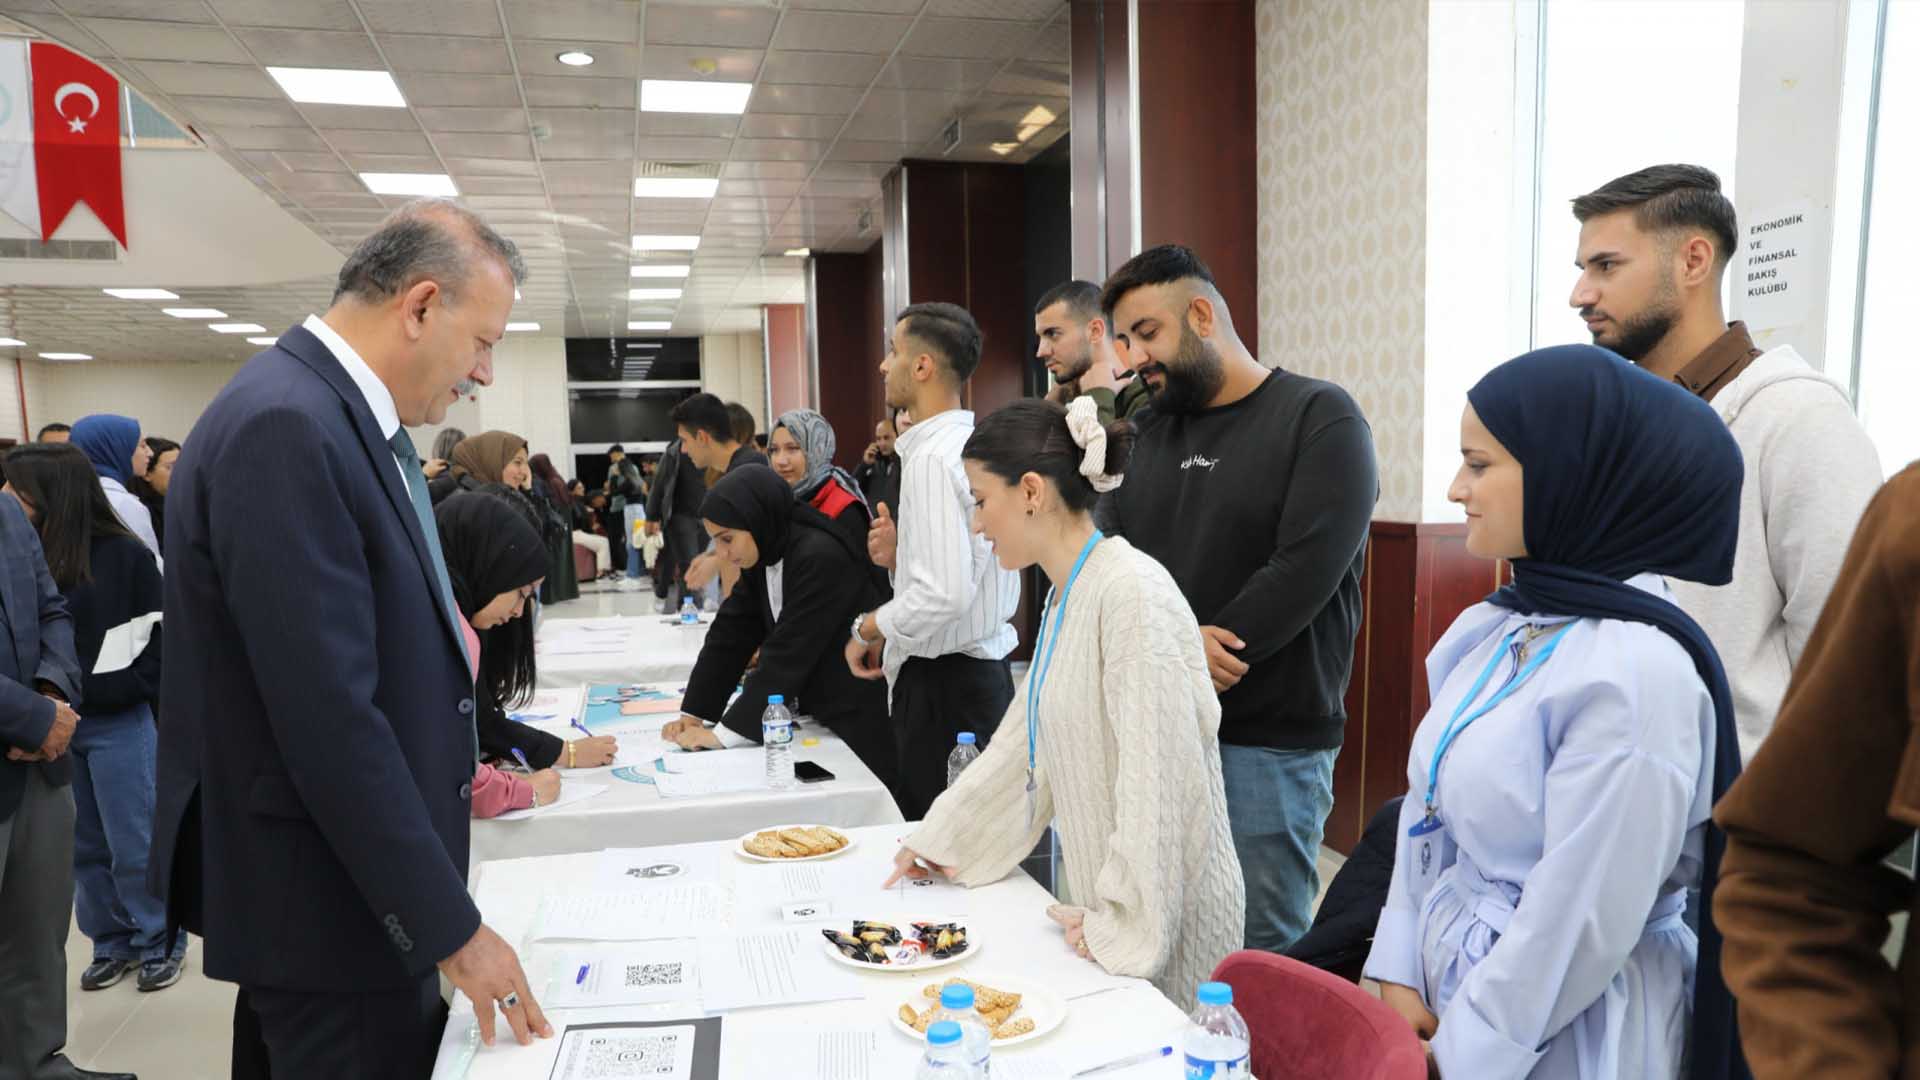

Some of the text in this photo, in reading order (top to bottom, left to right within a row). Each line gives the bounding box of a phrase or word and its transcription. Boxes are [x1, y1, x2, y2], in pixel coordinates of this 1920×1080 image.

[1750, 214, 1804, 235] EKONOMİK
[1750, 240, 1762, 251] VE
[1748, 248, 1798, 266] FİNANSAL
[1748, 268, 1777, 282] BAKIŞ
[1748, 281, 1788, 297] KULÜBÜ
